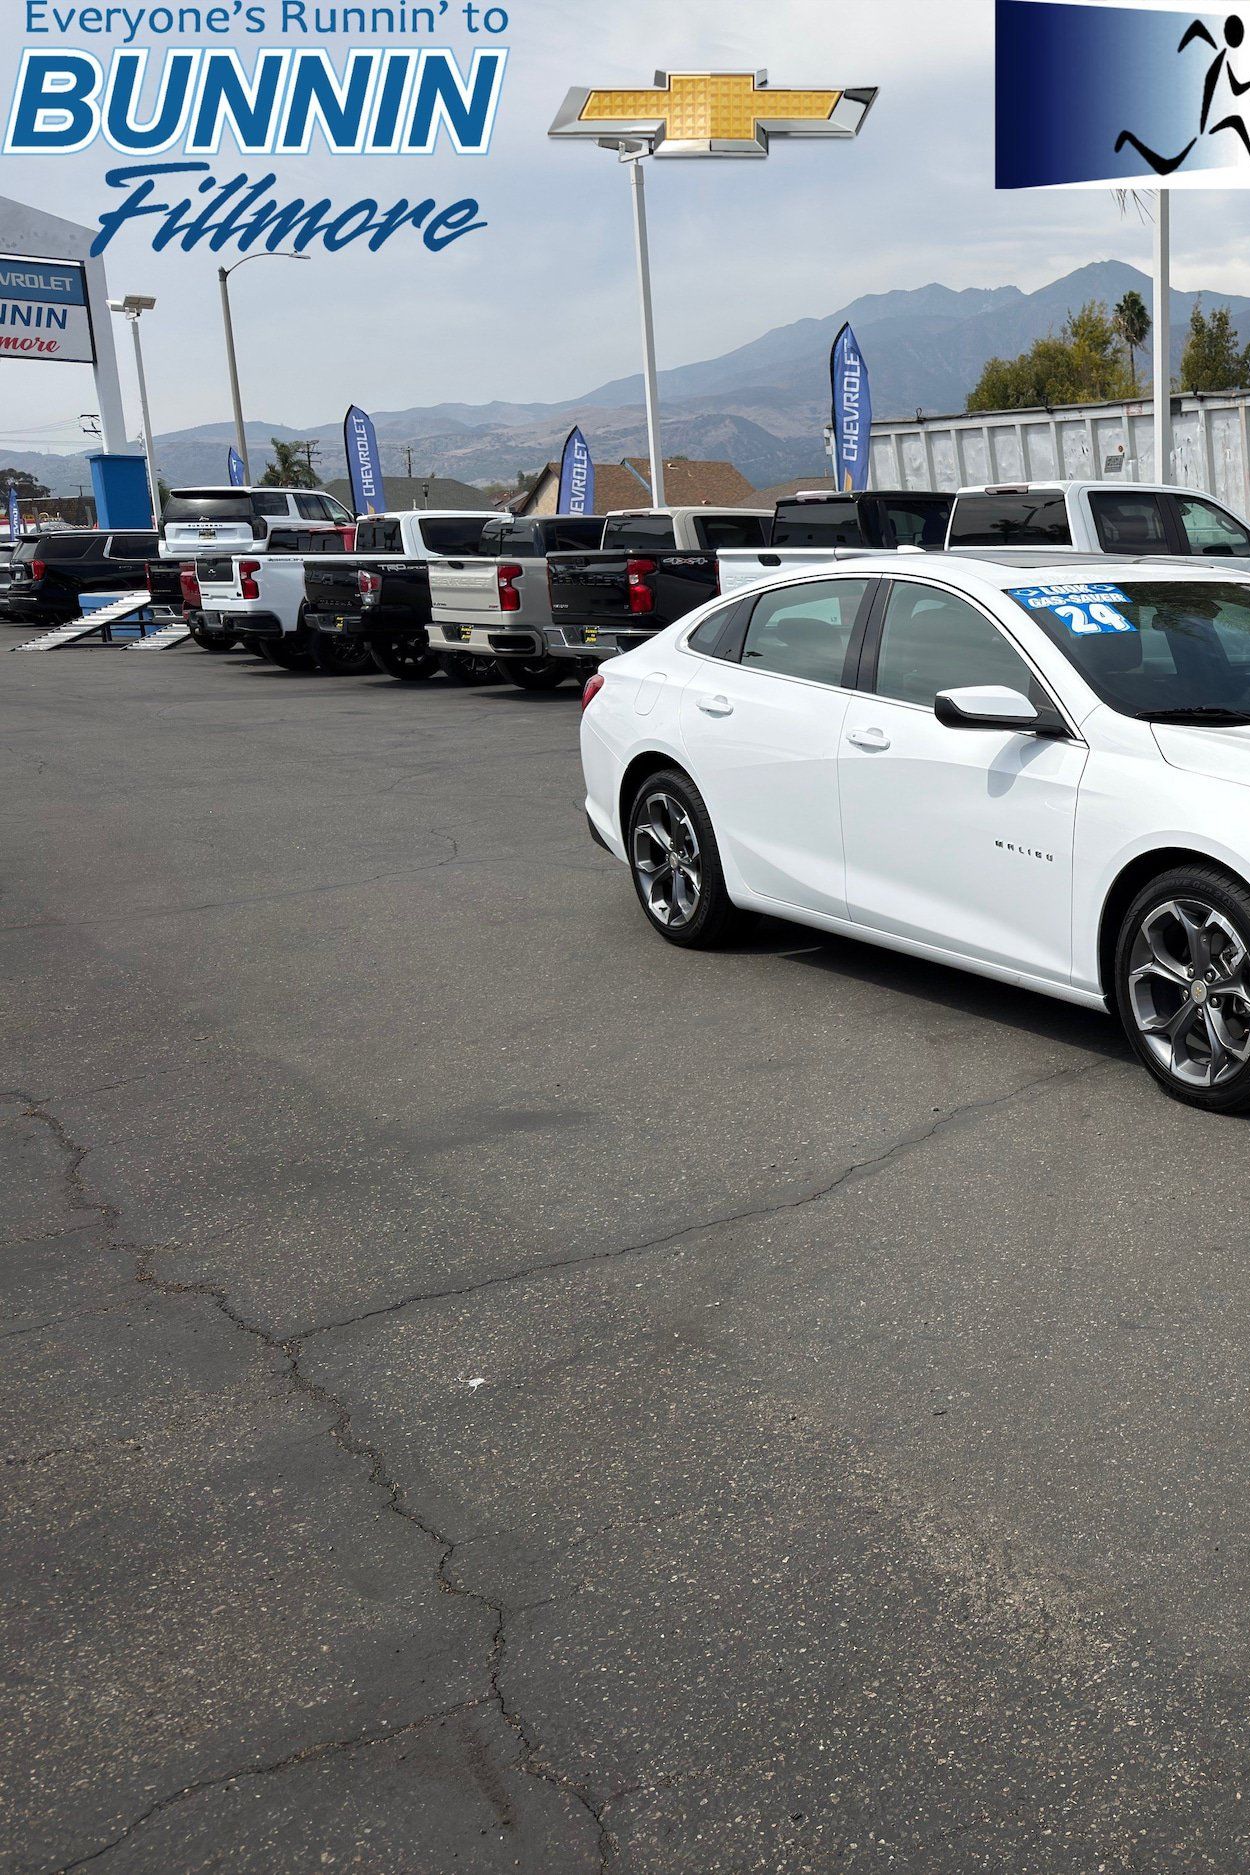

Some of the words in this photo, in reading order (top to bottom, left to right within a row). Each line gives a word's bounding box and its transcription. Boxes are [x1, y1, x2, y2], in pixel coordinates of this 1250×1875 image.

[352, 415, 376, 498] CHEVROLET
[1027, 592, 1127, 609] GAS-SAVER
[1038, 584, 1096, 596] LOOK
[1054, 603, 1131, 633] 24
[994, 839, 1053, 862] MALIBU
